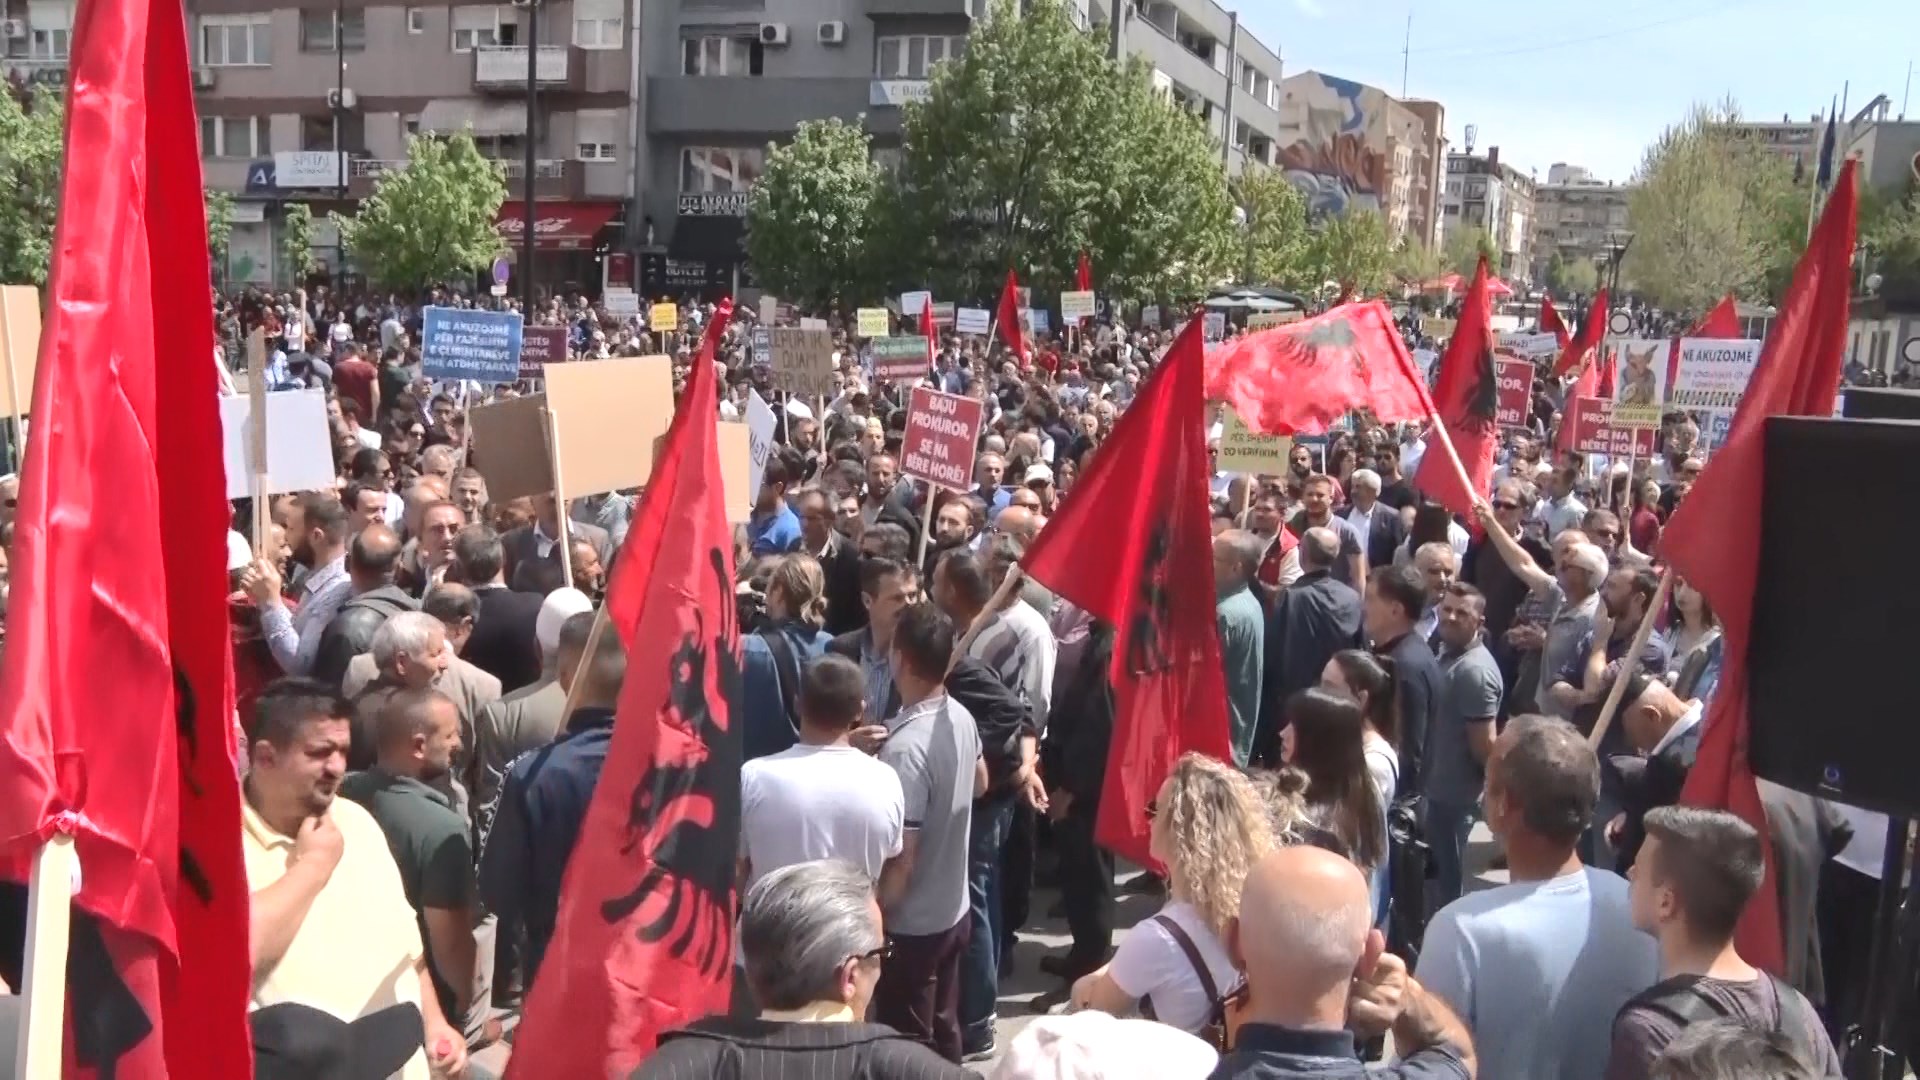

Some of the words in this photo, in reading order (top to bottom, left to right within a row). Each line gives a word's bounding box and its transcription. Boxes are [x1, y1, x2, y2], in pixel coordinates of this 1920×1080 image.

[929, 395, 957, 415] BAJU
[920, 438, 933, 455] SE
[933, 443, 949, 460] NA
